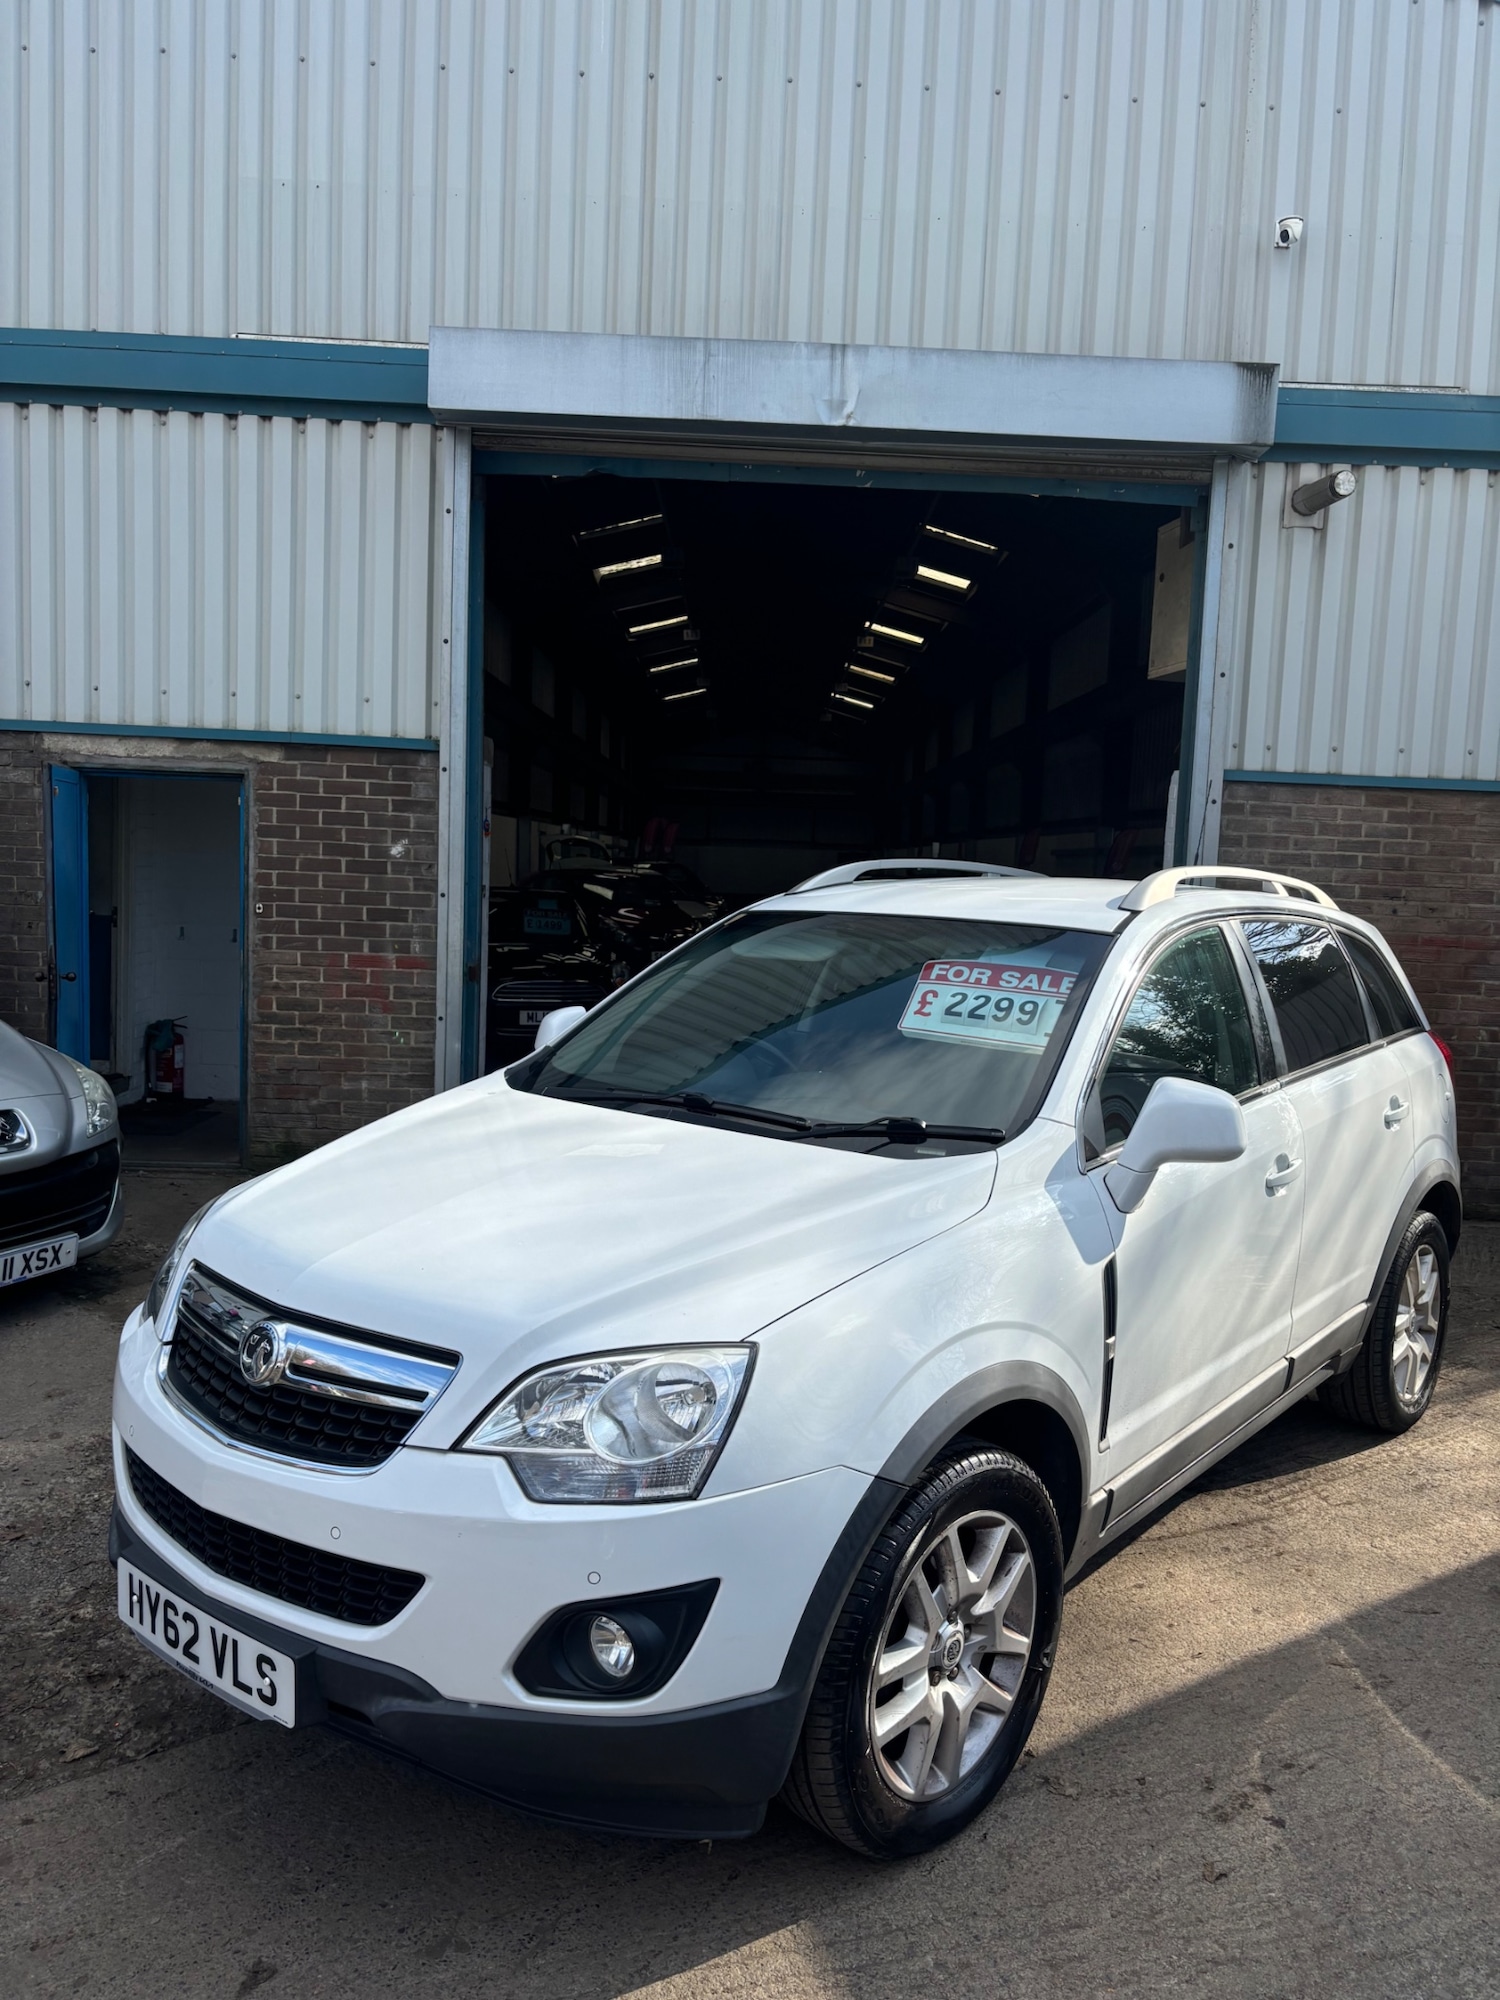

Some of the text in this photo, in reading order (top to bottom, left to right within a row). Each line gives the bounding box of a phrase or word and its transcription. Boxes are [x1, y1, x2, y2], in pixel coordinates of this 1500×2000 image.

[929, 964, 1078, 993] FOR SALE
[20, 1243, 63, 1276] XSX
[128, 1572, 278, 1707] HY62 VLS
